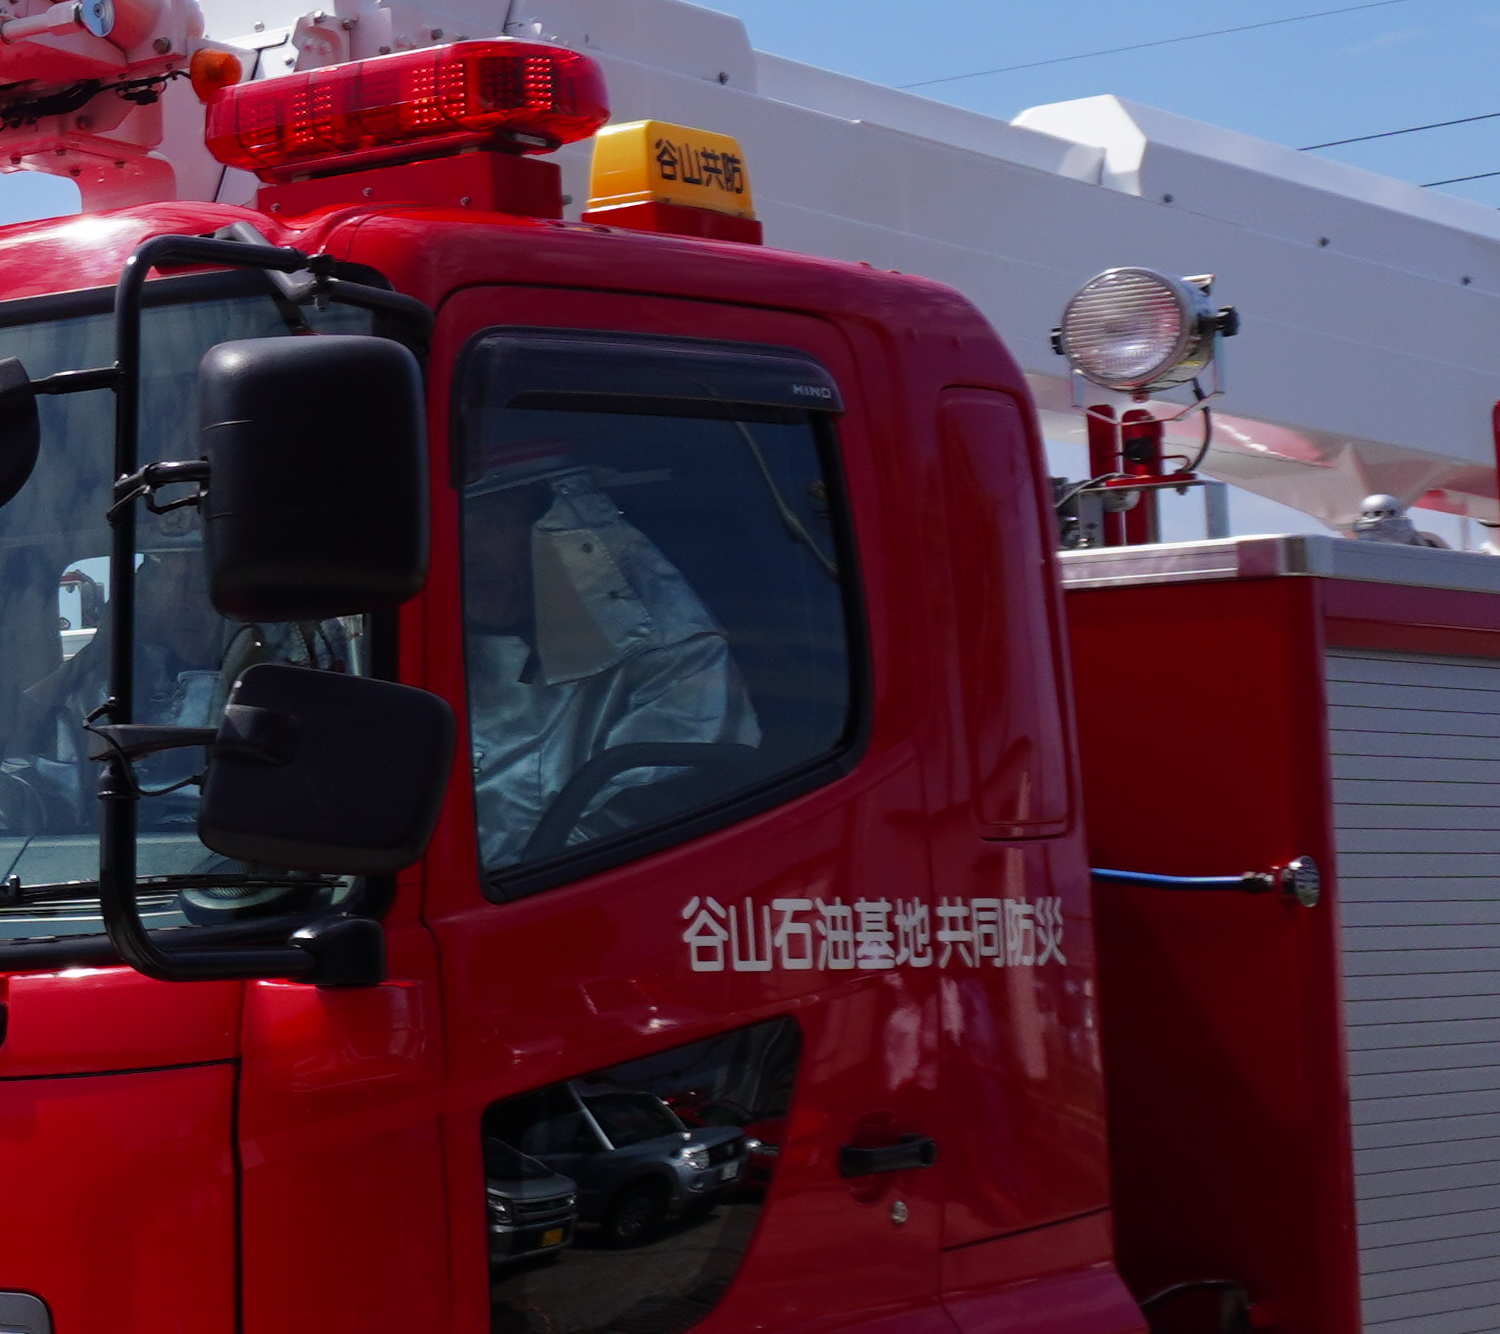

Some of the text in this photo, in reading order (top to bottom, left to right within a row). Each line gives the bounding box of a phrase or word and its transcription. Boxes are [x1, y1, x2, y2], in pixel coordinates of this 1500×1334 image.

[655, 139, 744, 194] 谷山共防
[792, 384, 831, 399] HINO
